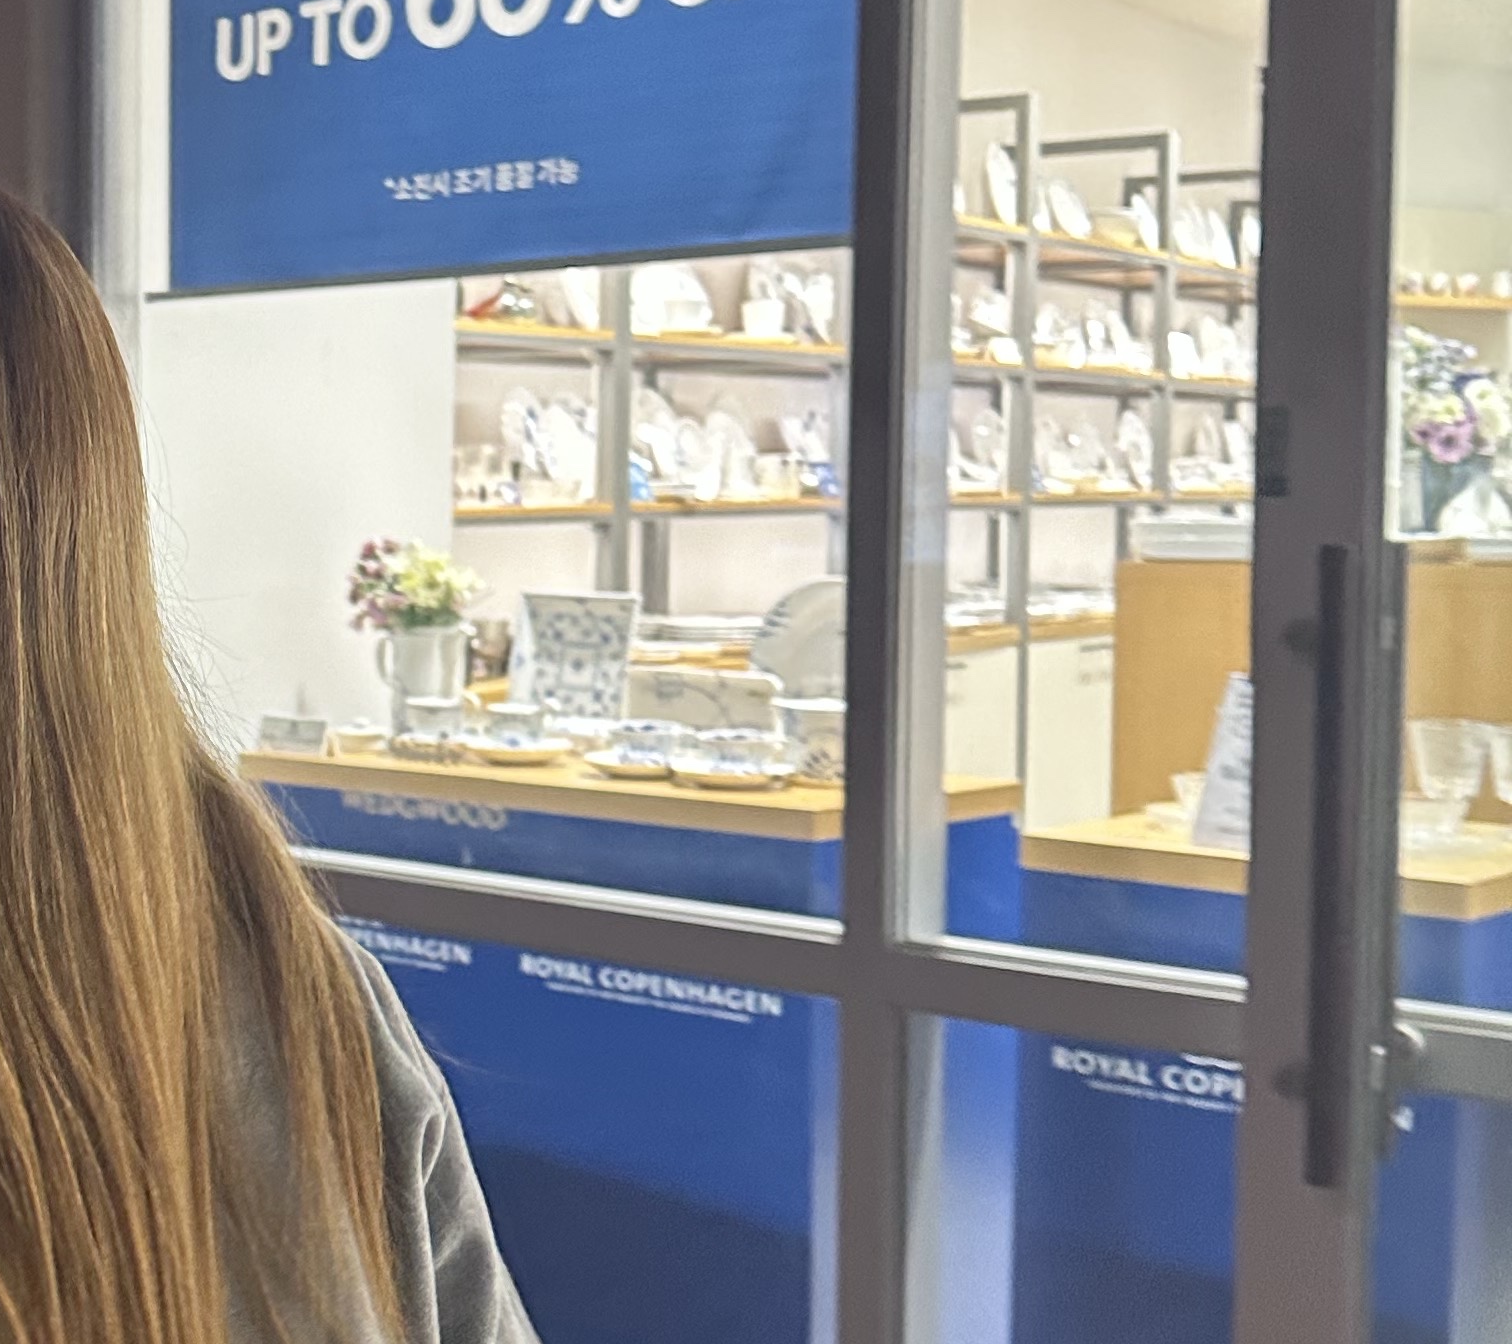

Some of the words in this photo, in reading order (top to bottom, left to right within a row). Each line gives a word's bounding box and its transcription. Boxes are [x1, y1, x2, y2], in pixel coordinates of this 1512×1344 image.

[216, 8, 292, 82] UP
[519, 953, 594, 986] ROYAL
[598, 966, 783, 1017] COPENHAGEN
[1051, 1045, 1153, 1086] ROYAL
